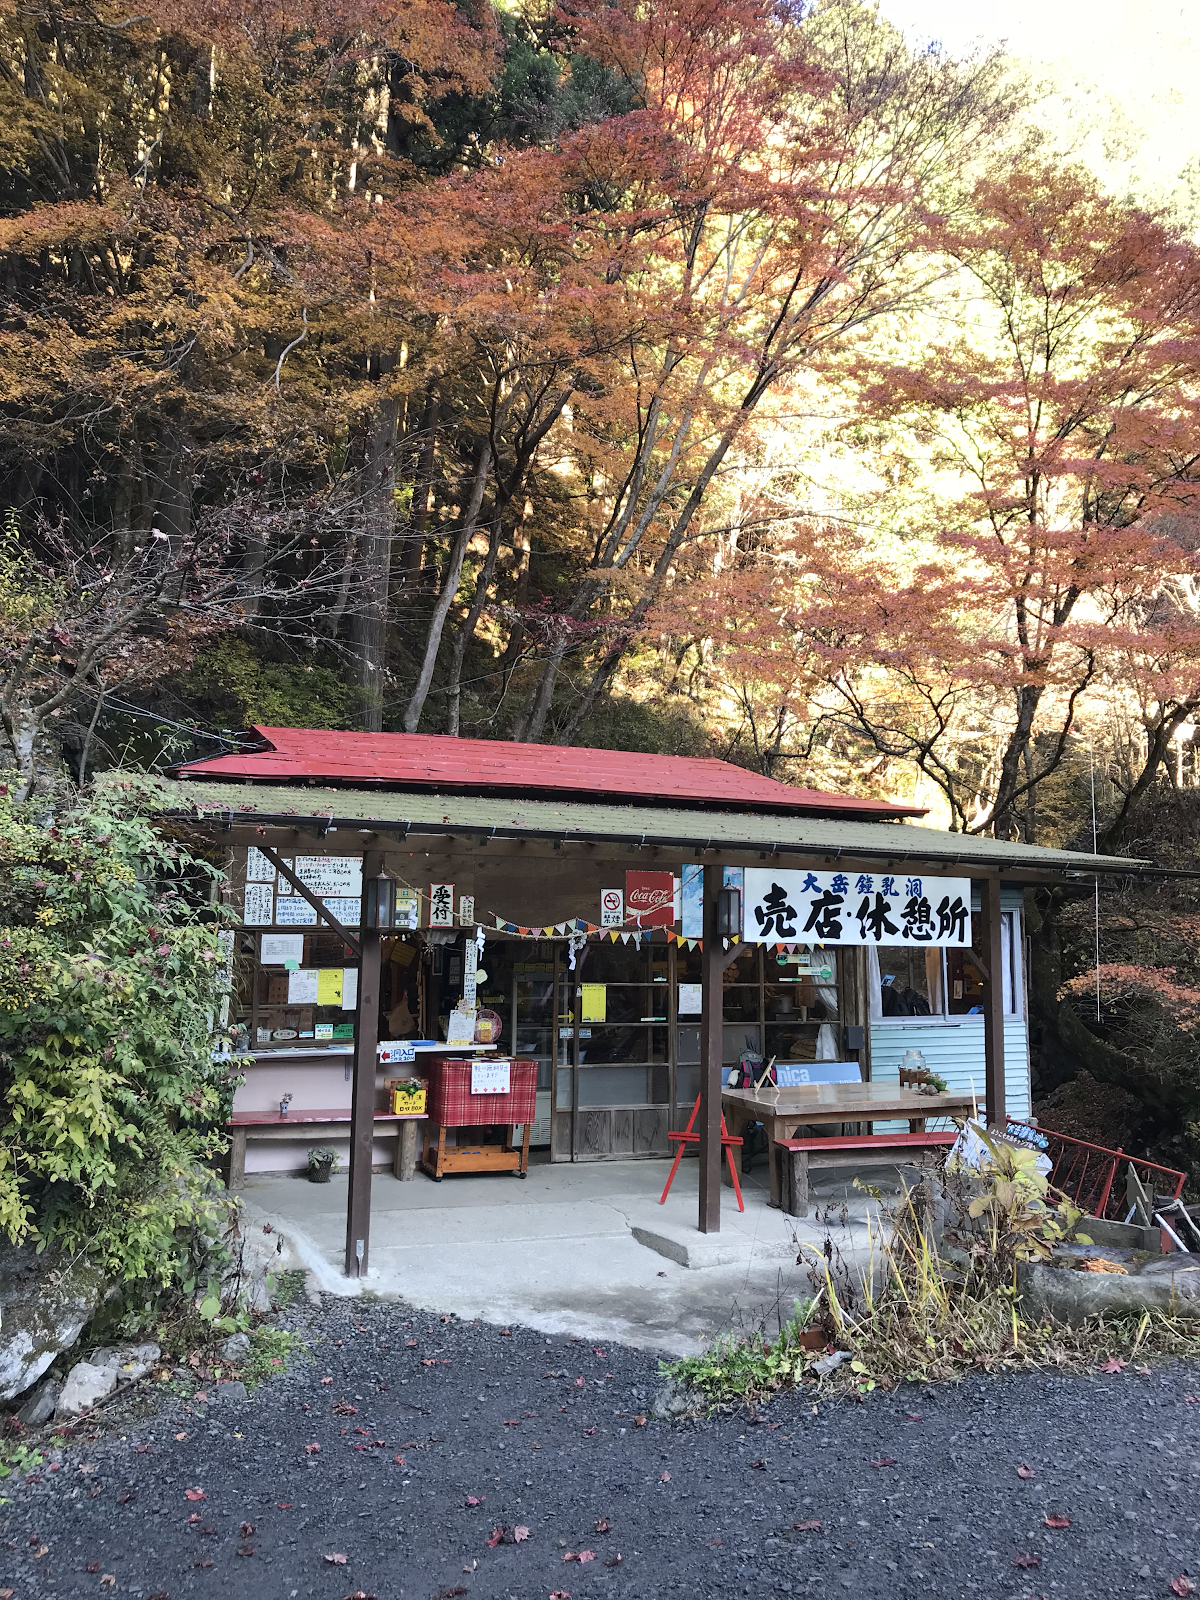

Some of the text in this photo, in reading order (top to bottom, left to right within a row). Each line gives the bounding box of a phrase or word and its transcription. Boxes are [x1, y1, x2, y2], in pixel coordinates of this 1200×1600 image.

[432, 885, 451, 920] 受付
[629, 889, 671, 903] Coca-Cola
[603, 914, 621, 924] 禁煙
[754, 883, 969, 942] 売店・休憩所
[777, 1066, 811, 1083] nica
